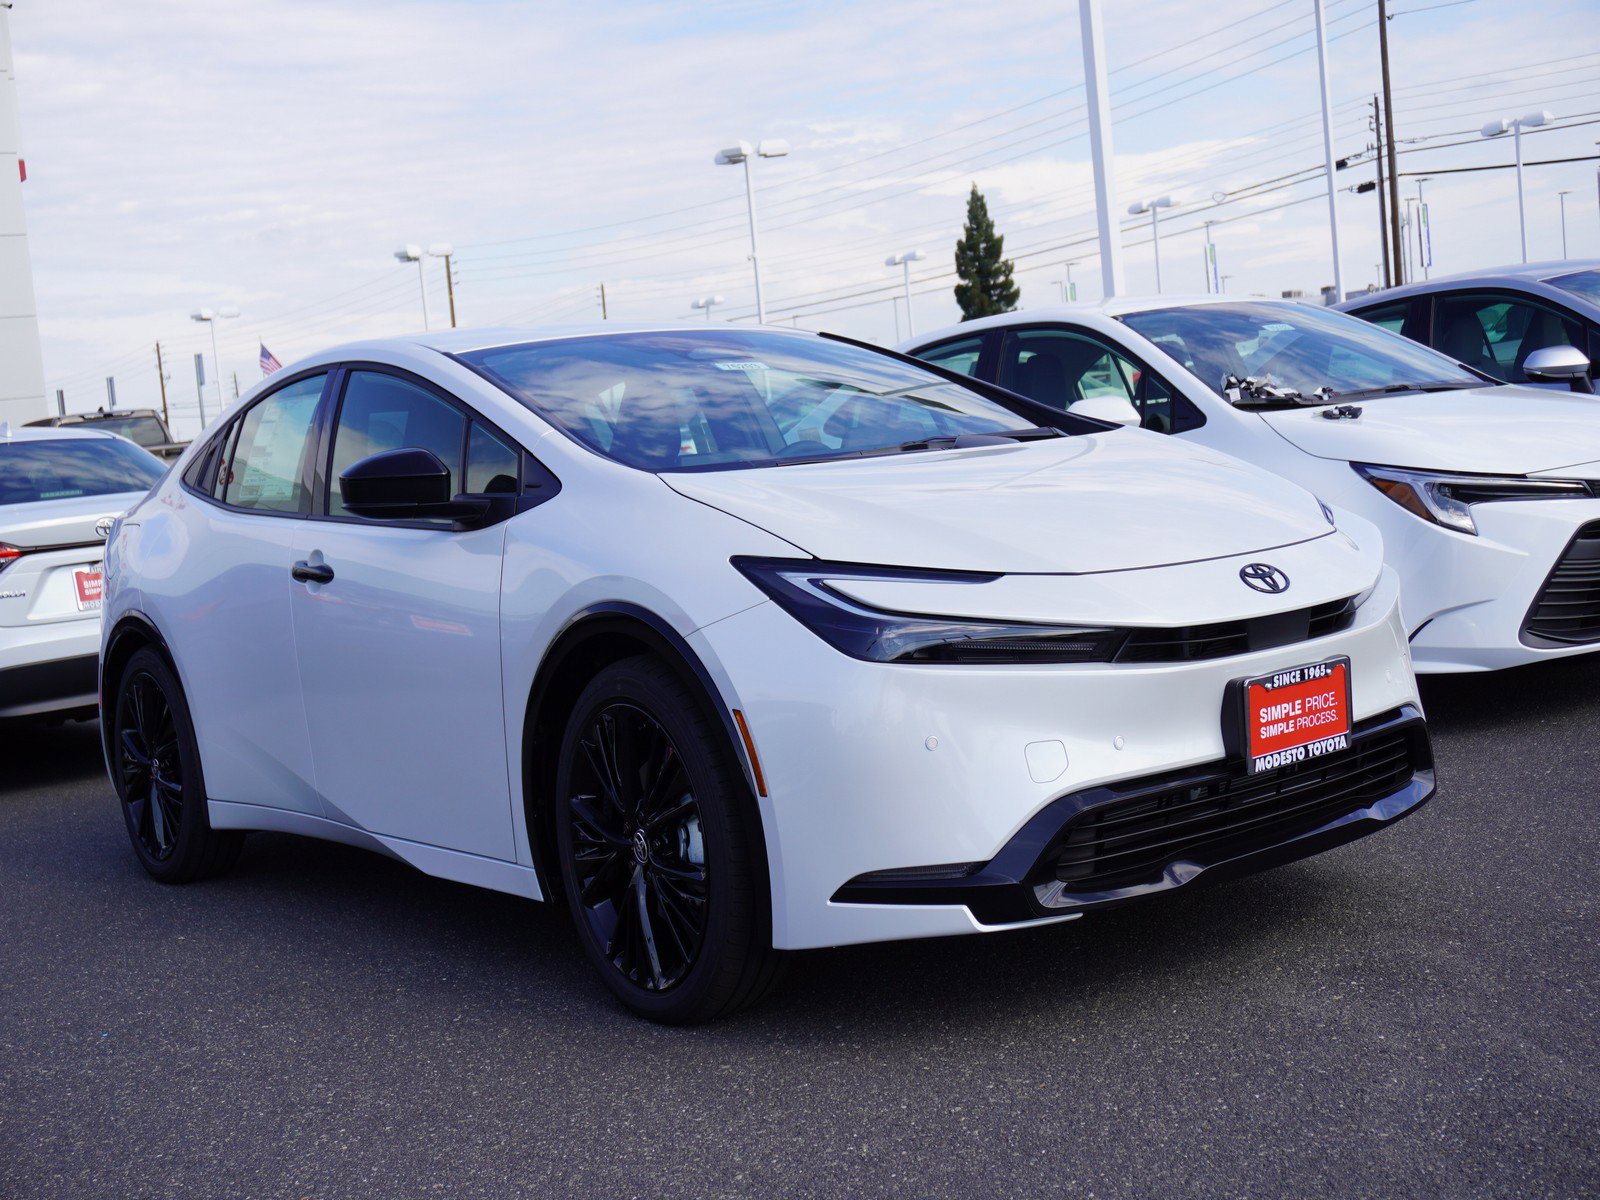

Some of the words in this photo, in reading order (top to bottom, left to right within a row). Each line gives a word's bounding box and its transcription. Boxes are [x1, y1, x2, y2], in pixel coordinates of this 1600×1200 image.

[83, 579, 102, 589] SIMP
[84, 587, 102, 596] SIMP
[1273, 672, 1301, 688] SINCE
[1304, 664, 1326, 680] 1965
[1259, 700, 1302, 723] SIMPLE
[1305, 691, 1338, 713] PRICE.
[1260, 719, 1295, 739] SIMPLE
[1296, 709, 1339, 730] PROCESS.
[1255, 747, 1305, 772] MODESTO
[1307, 734, 1347, 756] TOYOTA
